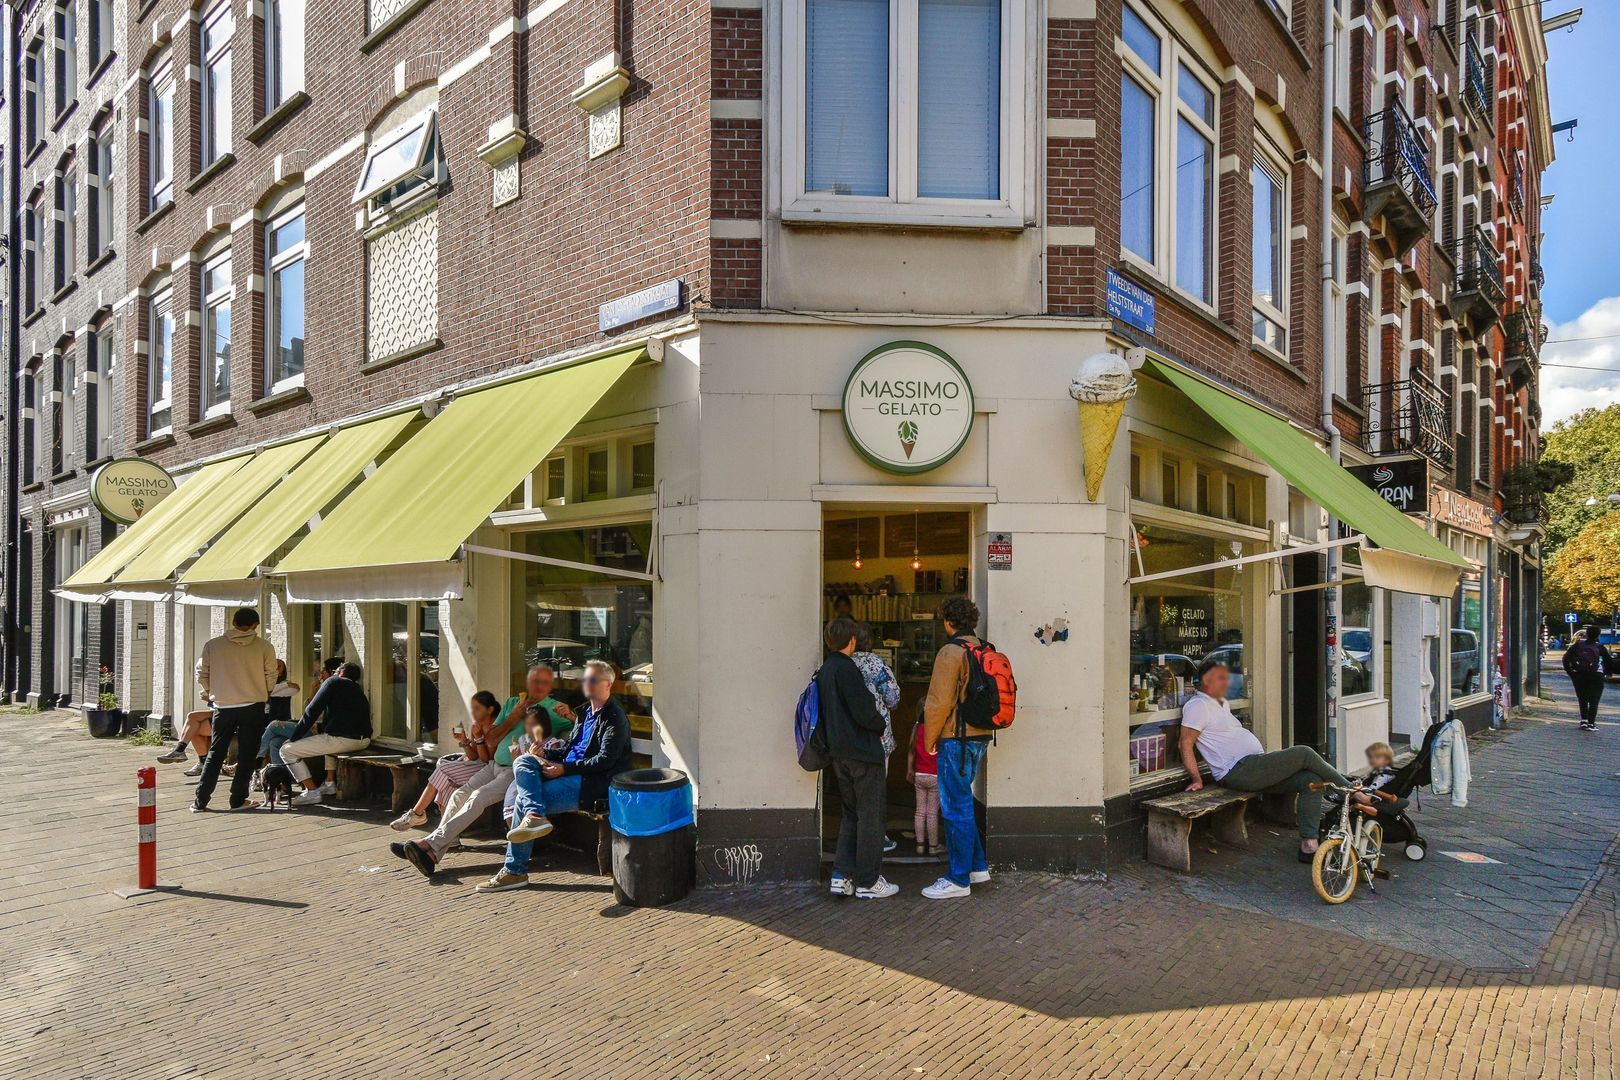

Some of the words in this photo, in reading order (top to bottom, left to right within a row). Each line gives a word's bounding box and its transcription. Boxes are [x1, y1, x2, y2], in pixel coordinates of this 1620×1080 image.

[1107, 271, 1131, 294] TWEEDE
[1131, 284, 1143, 301] VAN
[1143, 292, 1153, 306] DER
[1107, 289, 1144, 317] HELSTSTRAAT
[860, 380, 959, 399] MASSIMO
[878, 402, 942, 416] GELATO
[106, 476, 168, 489] MASSIMO
[118, 487, 158, 496] GELATO
[1374, 486, 1413, 509] YRAN
[1182, 609, 1205, 620] GELATO
[1179, 627, 1199, 638] MAKES
[1200, 627, 1208, 638] US
[1183, 645, 1204, 656] HAPPY.
